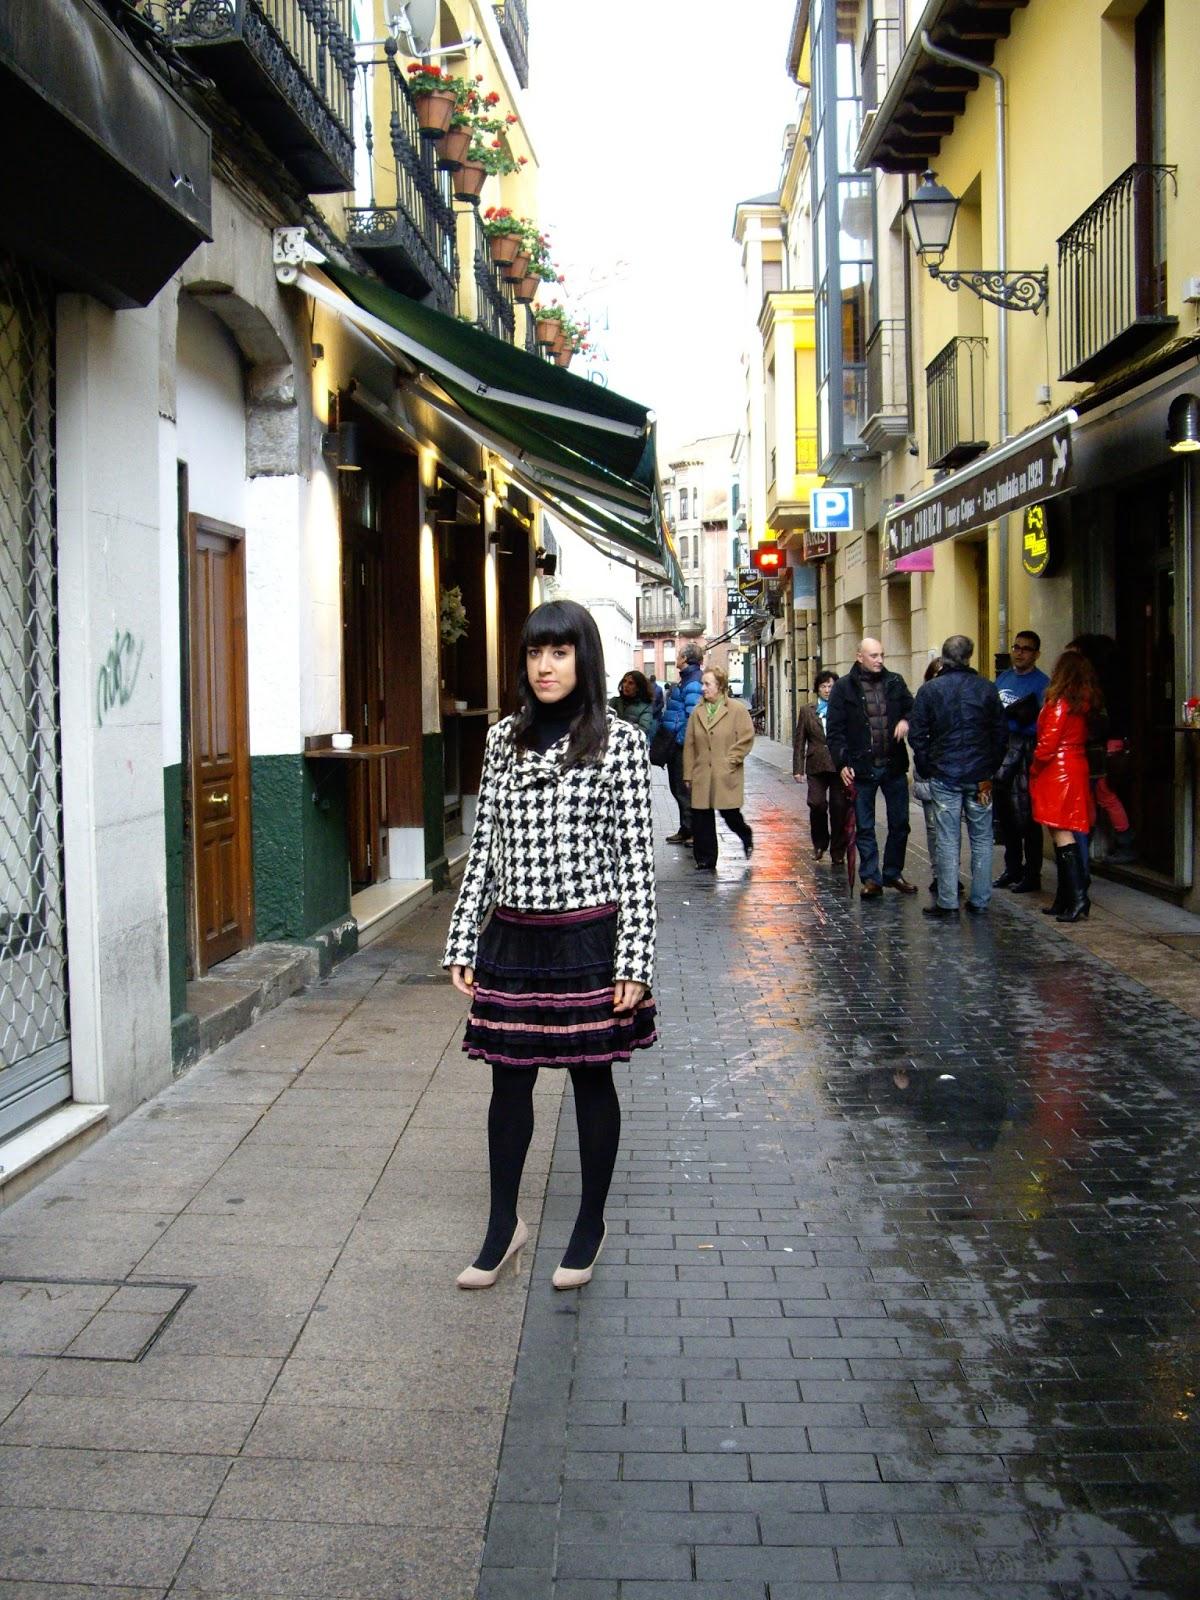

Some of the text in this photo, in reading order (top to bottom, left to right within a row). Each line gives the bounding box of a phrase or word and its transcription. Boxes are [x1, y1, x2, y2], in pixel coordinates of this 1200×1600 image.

[817, 493, 845, 528] P
[901, 519, 913, 549] Bar
[914, 501, 942, 543] CORREO
[984, 487, 996, 511] Casa
[1028, 458, 1043, 491] 1929
